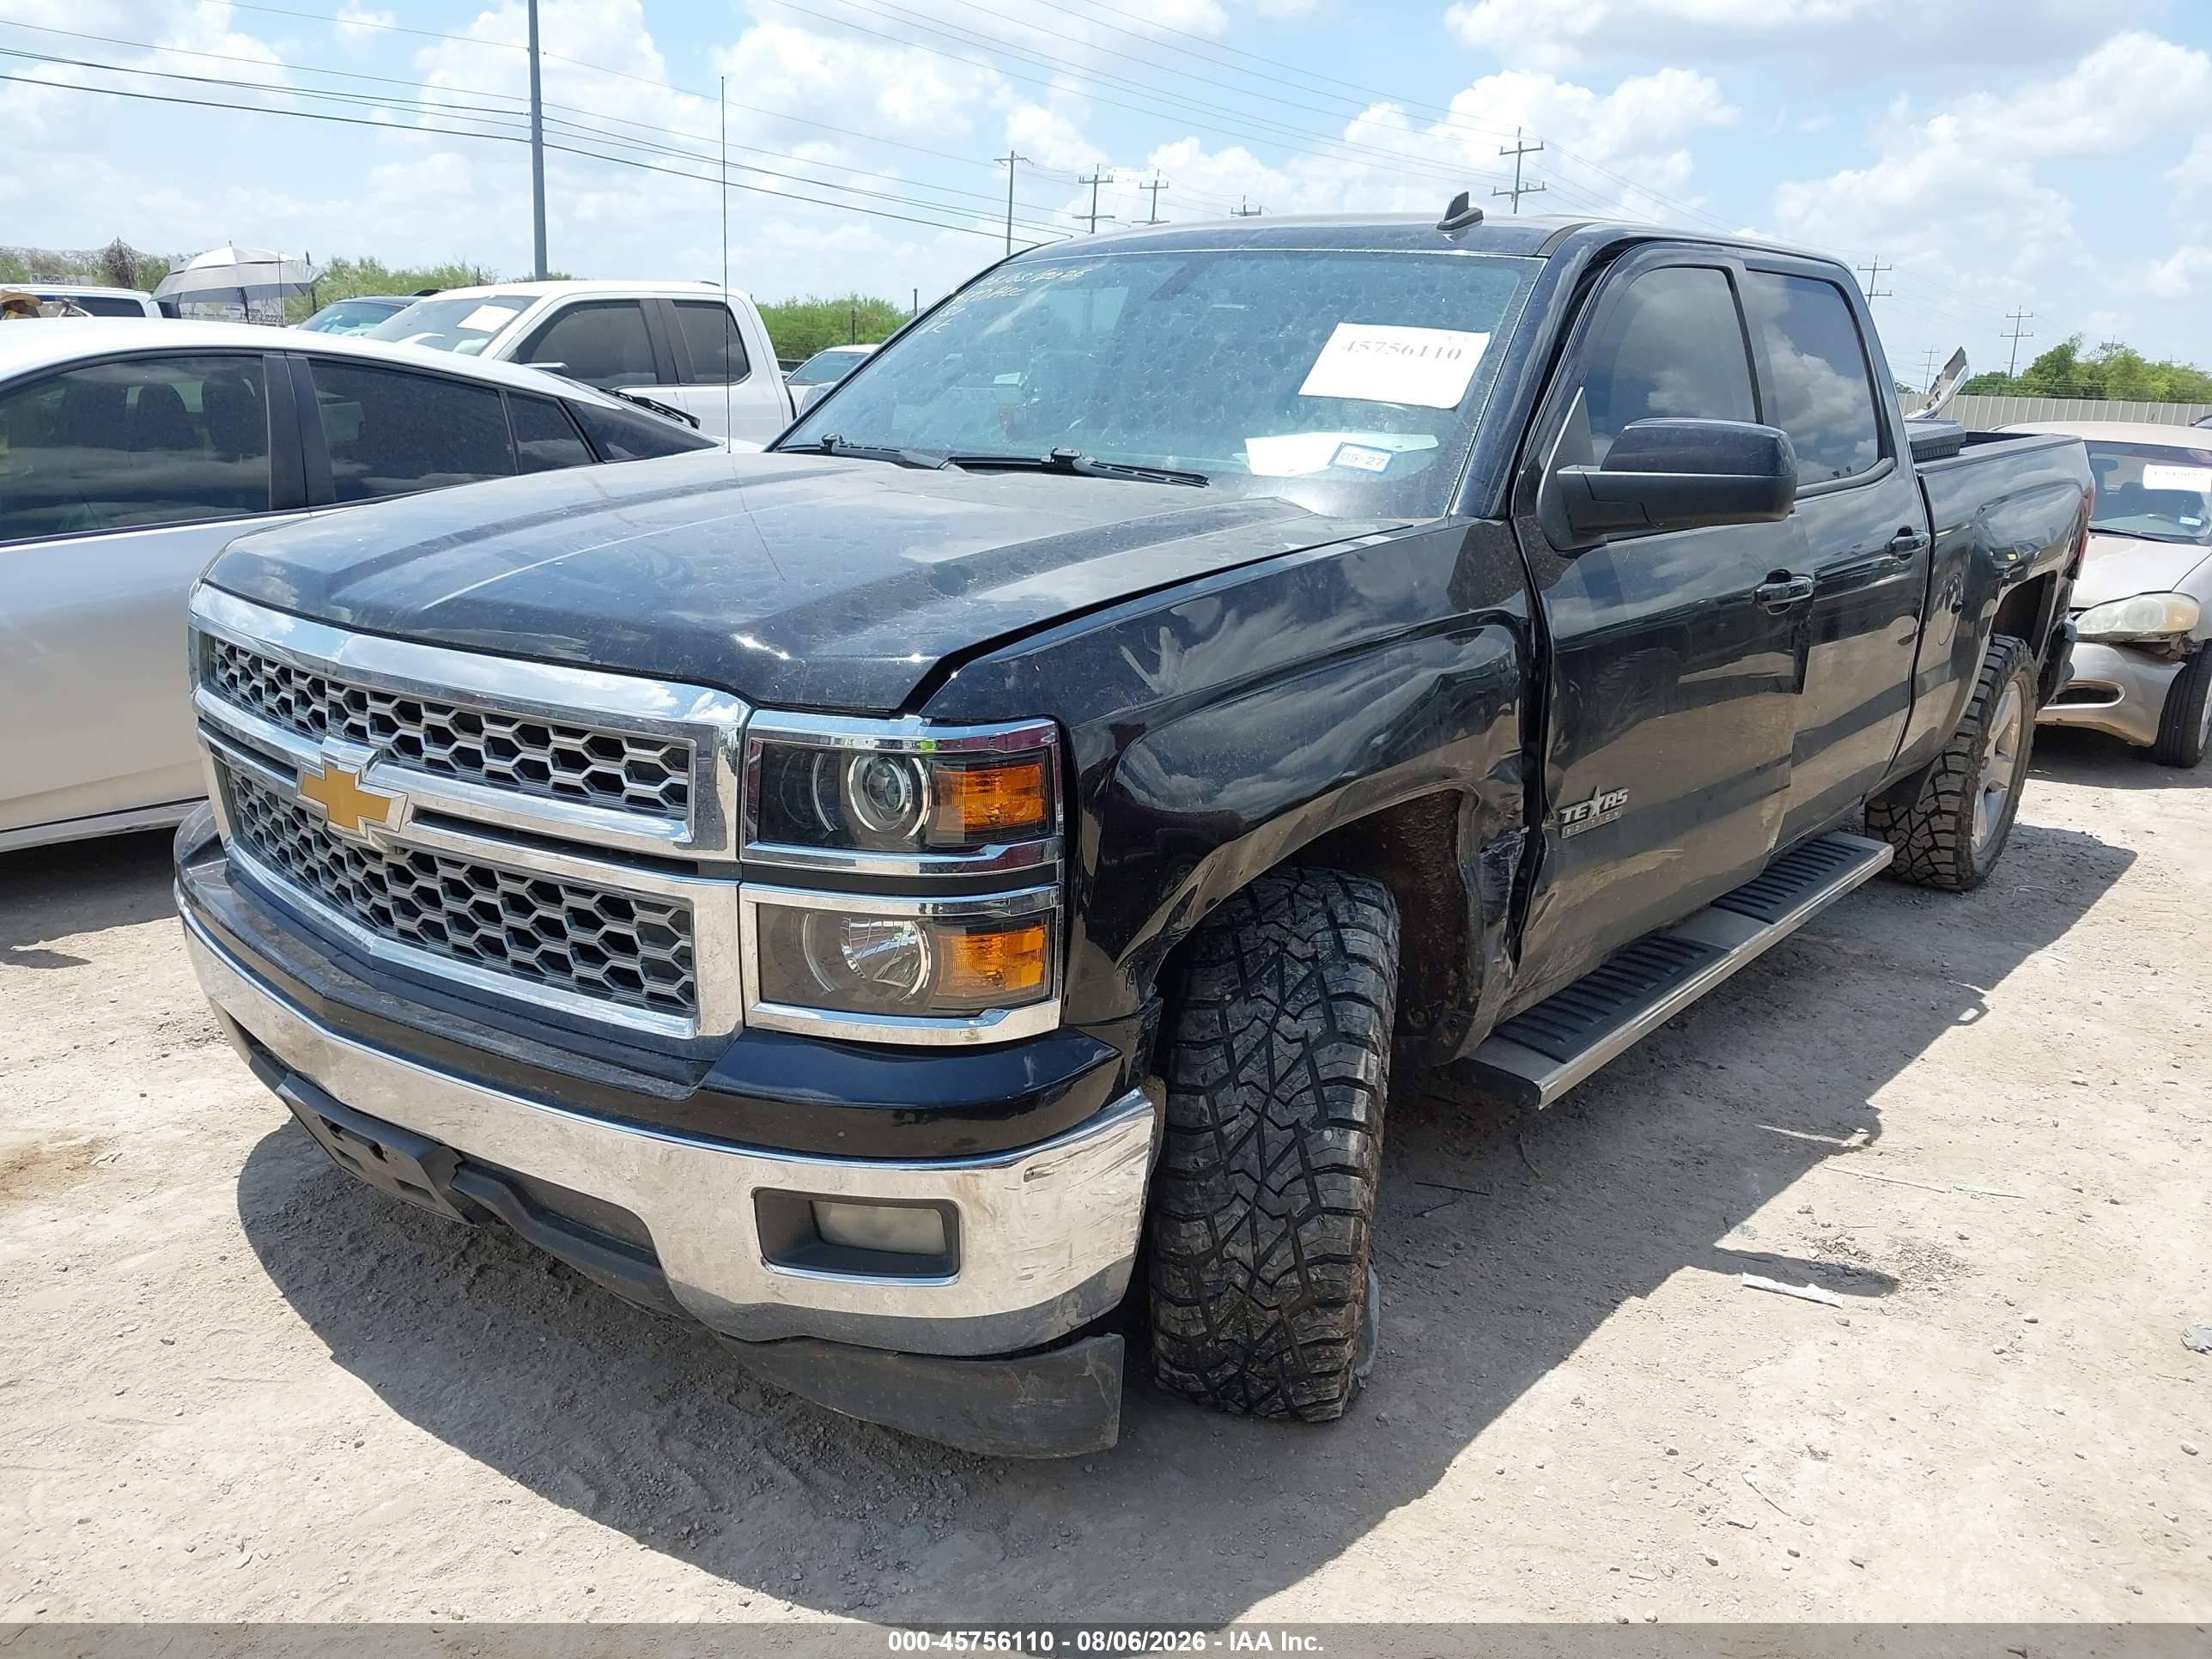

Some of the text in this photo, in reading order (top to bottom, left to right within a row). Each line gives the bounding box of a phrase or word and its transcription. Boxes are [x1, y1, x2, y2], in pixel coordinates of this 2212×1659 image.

[1341, 340, 1462, 361] 45756110
[1559, 785, 1629, 824] TEXAS
[1565, 810, 1620, 836] EDITION
